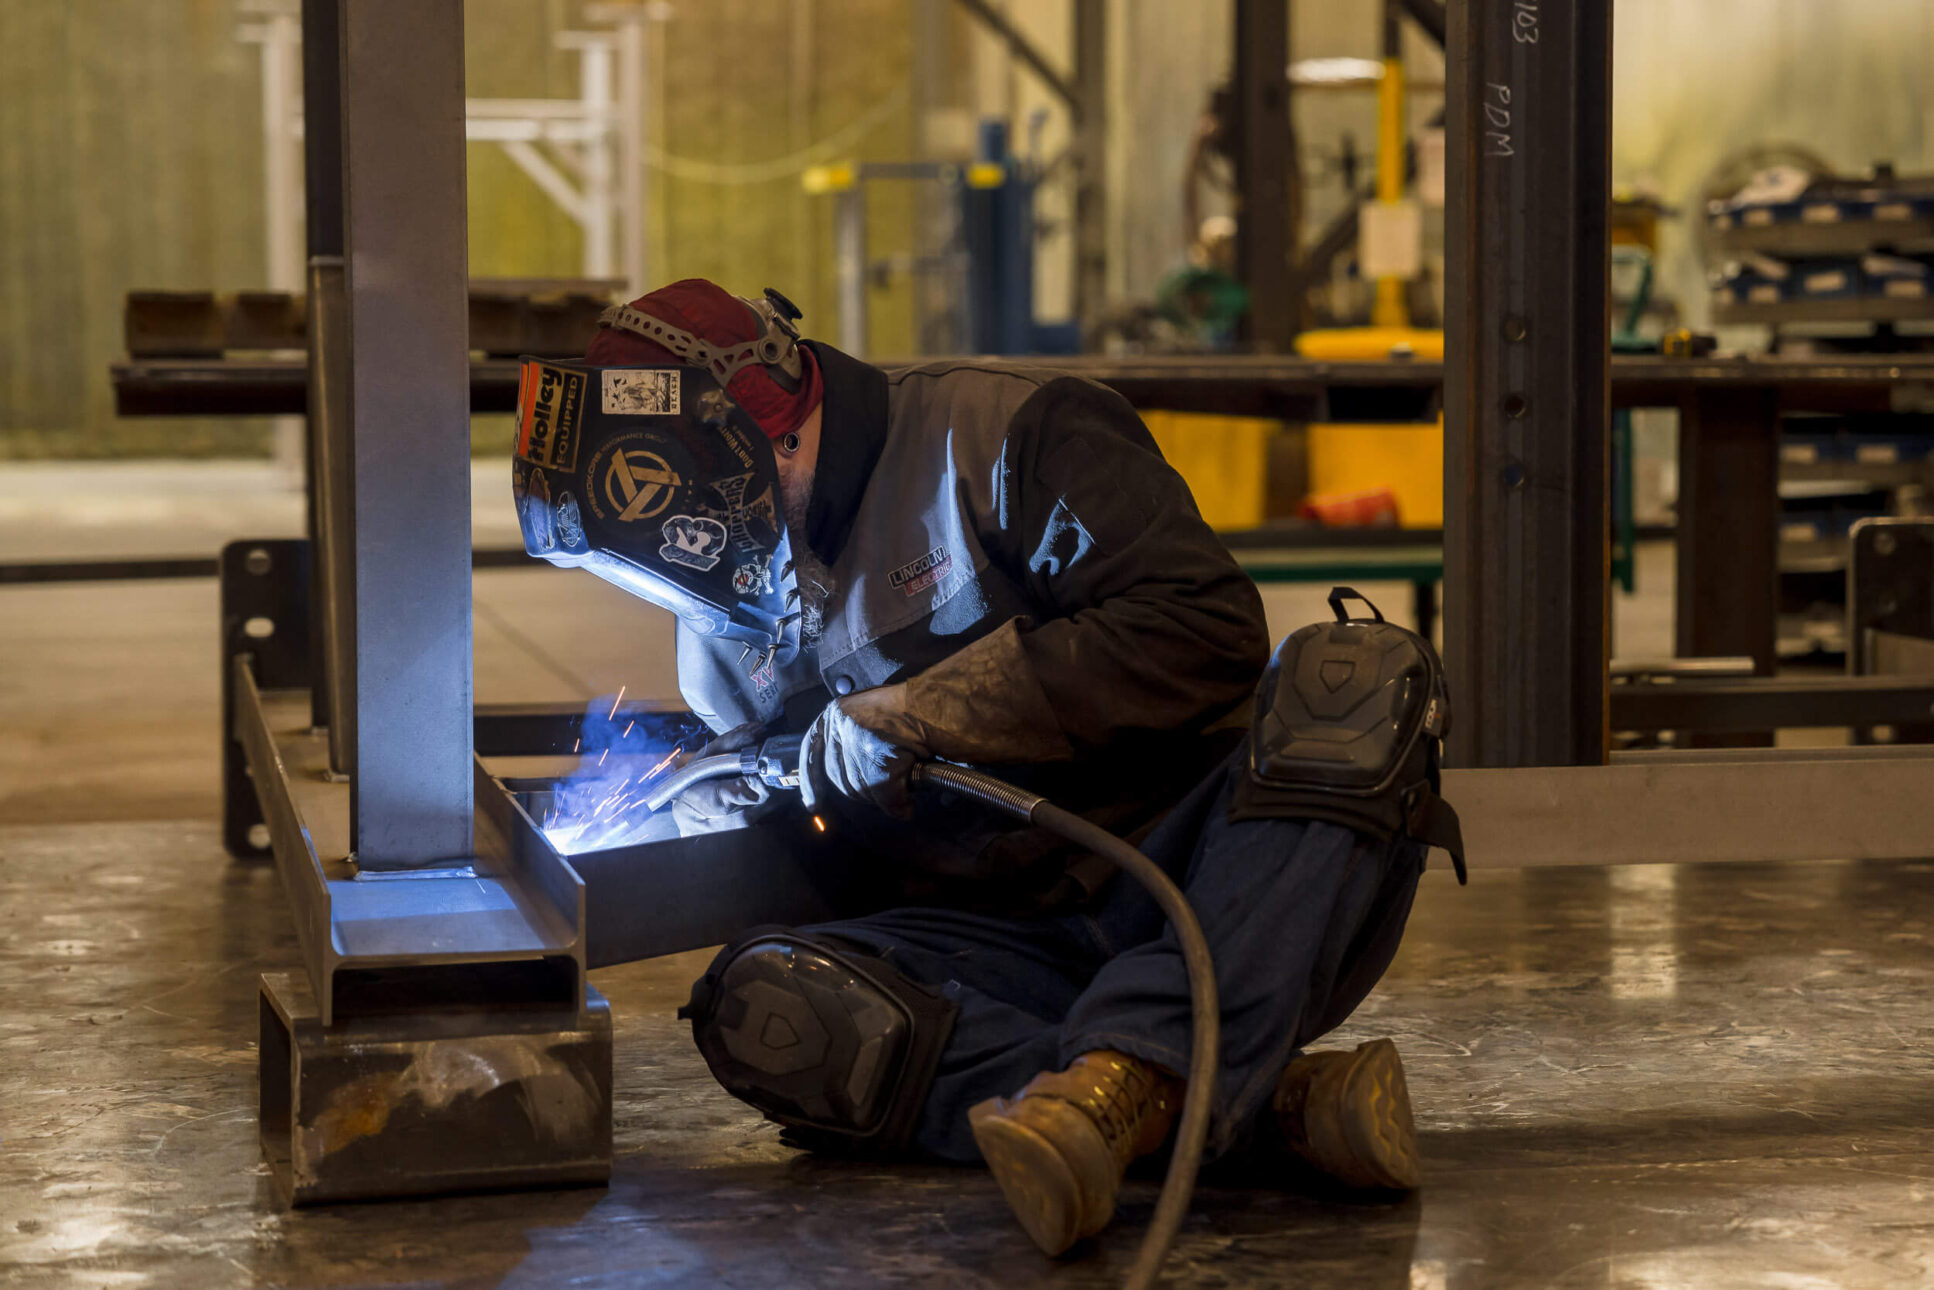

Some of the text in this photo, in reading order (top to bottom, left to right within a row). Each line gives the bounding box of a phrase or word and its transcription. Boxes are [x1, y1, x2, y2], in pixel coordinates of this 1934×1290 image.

[1483, 82, 1515, 157] PDM
[528, 367, 563, 462] Holley
[556, 376, 578, 464] EQUIPPED
[891, 547, 944, 584] LINCOLN
[911, 561, 951, 590] ELECTRIC
